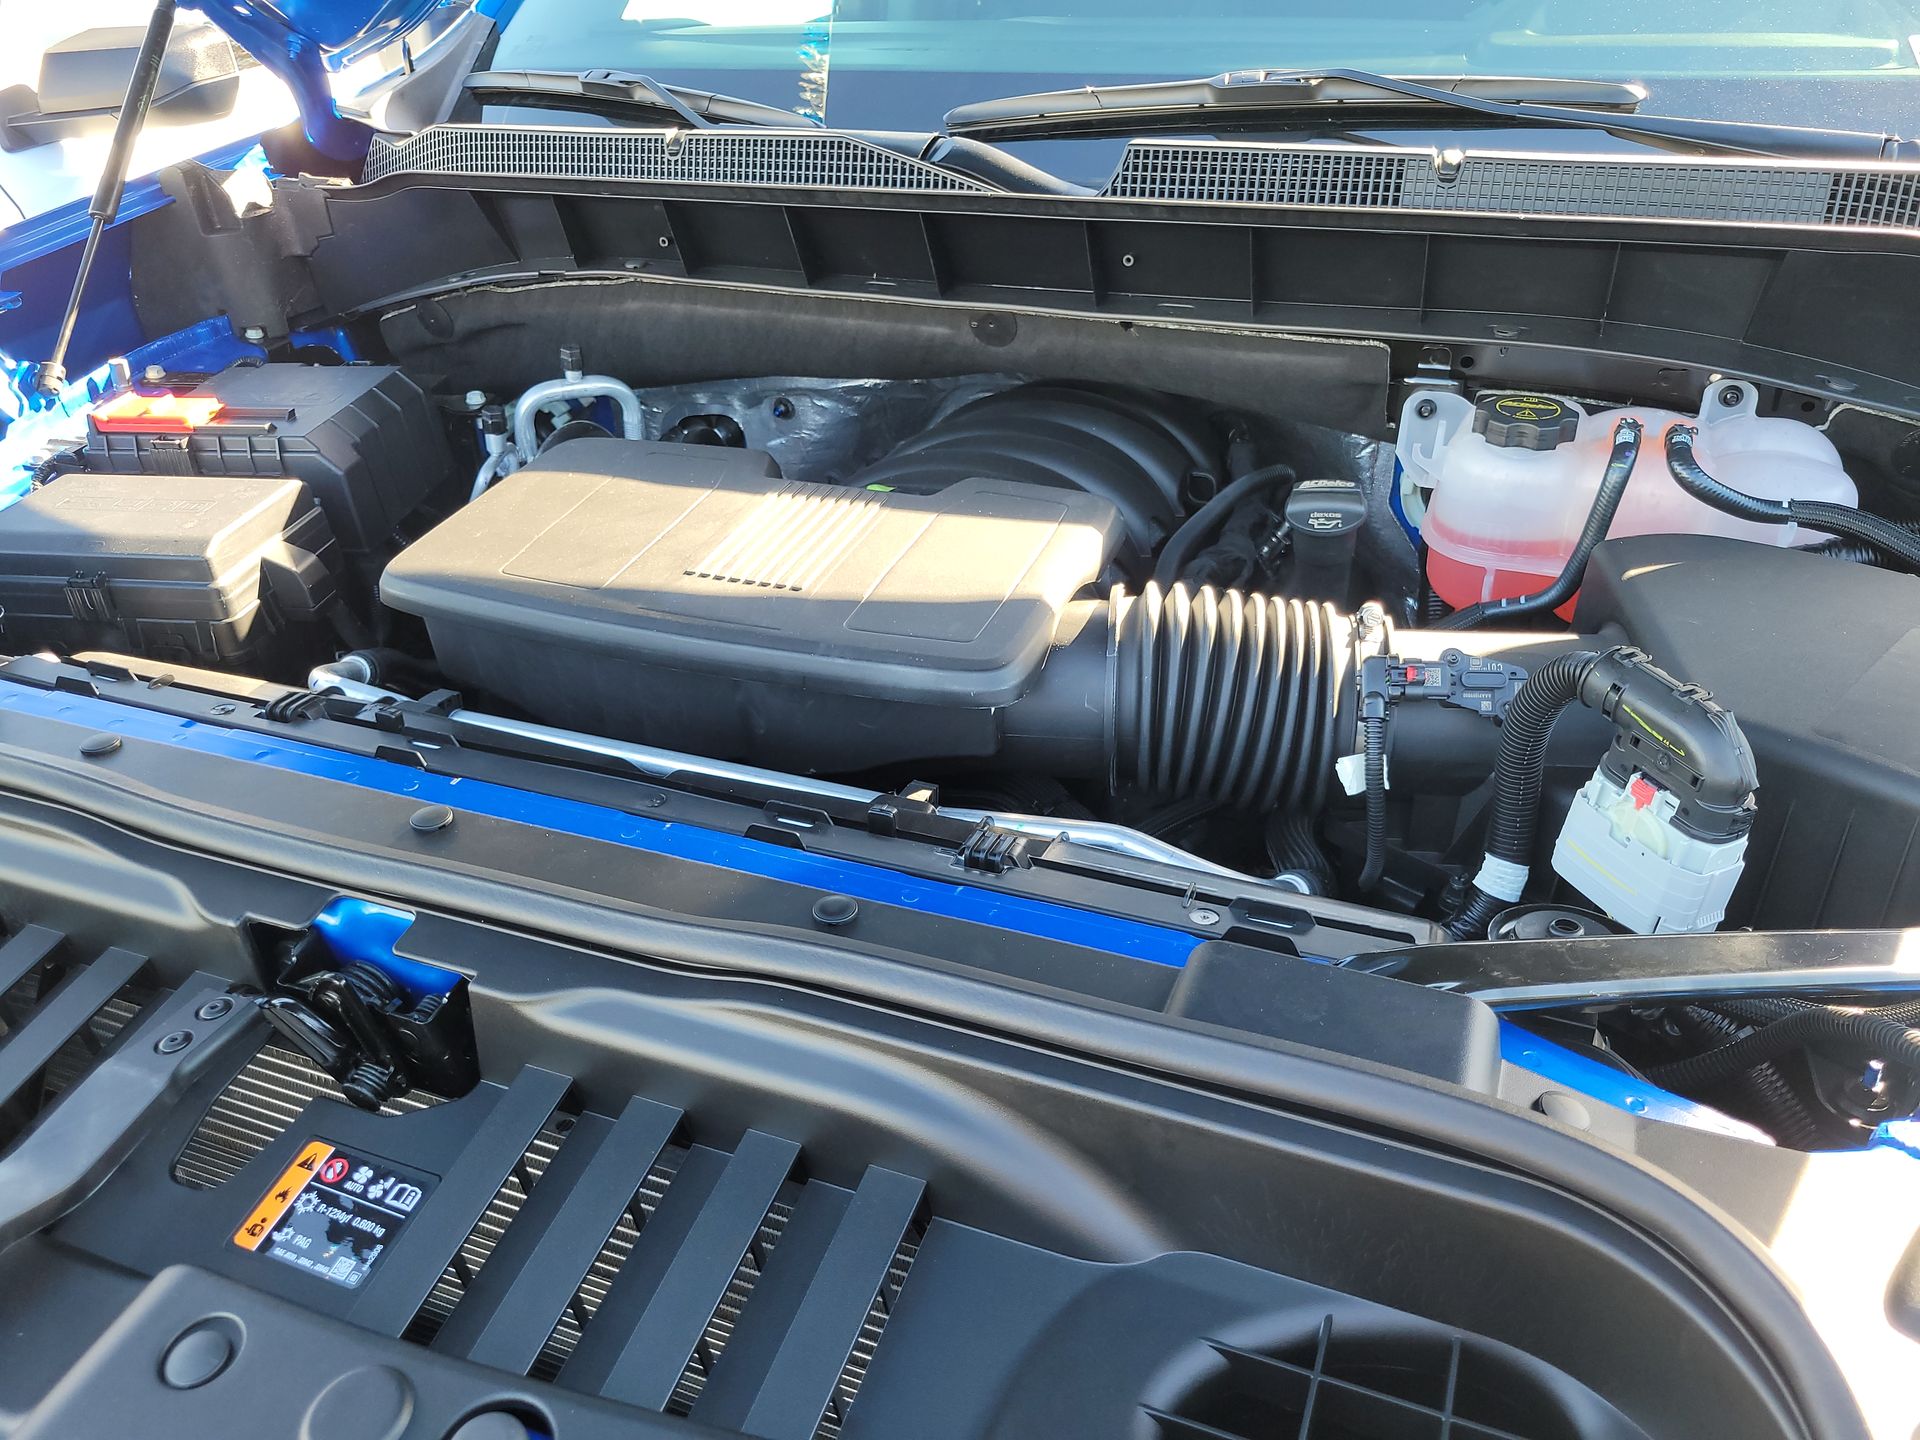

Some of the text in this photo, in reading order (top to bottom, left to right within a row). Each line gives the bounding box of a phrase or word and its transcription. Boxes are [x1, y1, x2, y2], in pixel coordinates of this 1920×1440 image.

[1299, 480, 1355, 489] ACDelco
[343, 1181, 364, 1193] AUTO
[317, 1203, 386, 1238] R-1234yf 0.600 kg
[292, 1234, 312, 1250] PAG
